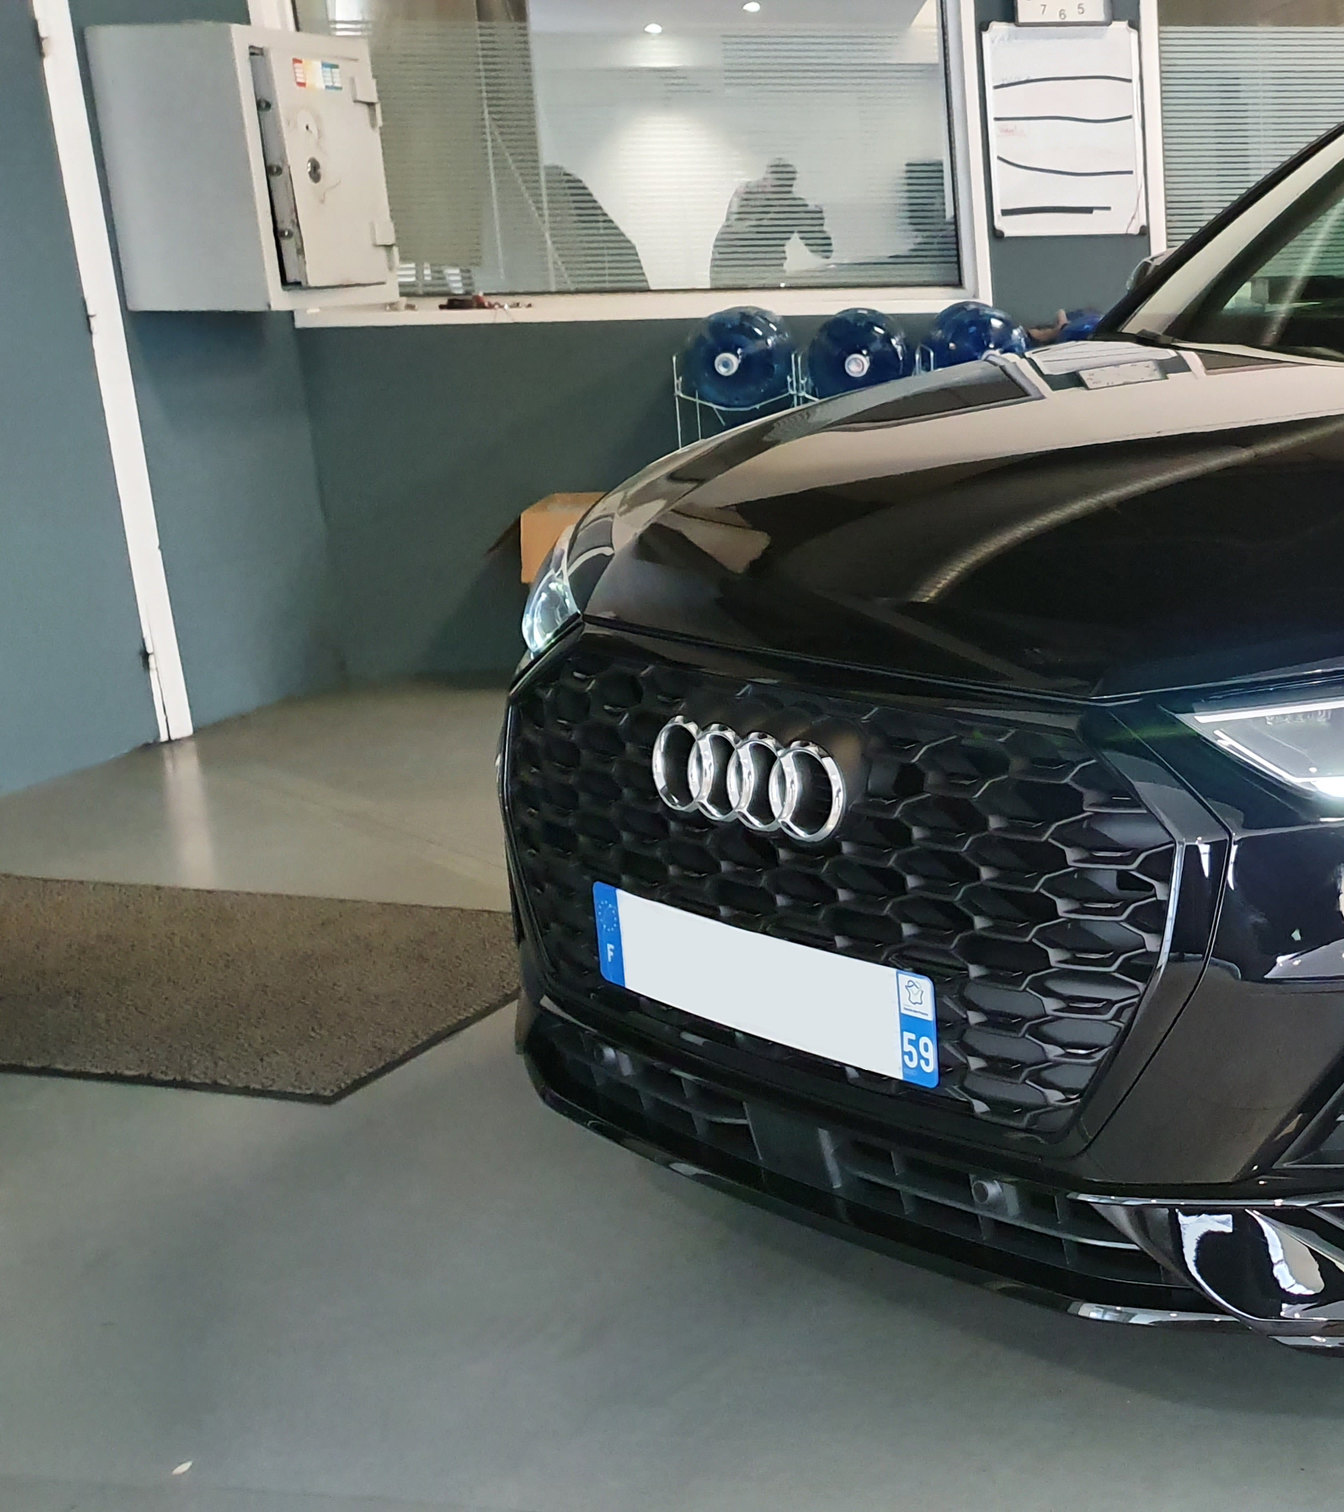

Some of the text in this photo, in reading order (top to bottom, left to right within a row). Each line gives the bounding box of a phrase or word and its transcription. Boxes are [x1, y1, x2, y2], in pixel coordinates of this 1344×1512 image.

[1040, 4, 1047, 15] 7
[1058, 9, 1067, 20] 6
[1077, 3, 1085, 15] 5
[607, 943, 615, 963] F
[902, 1030, 934, 1073] 59
